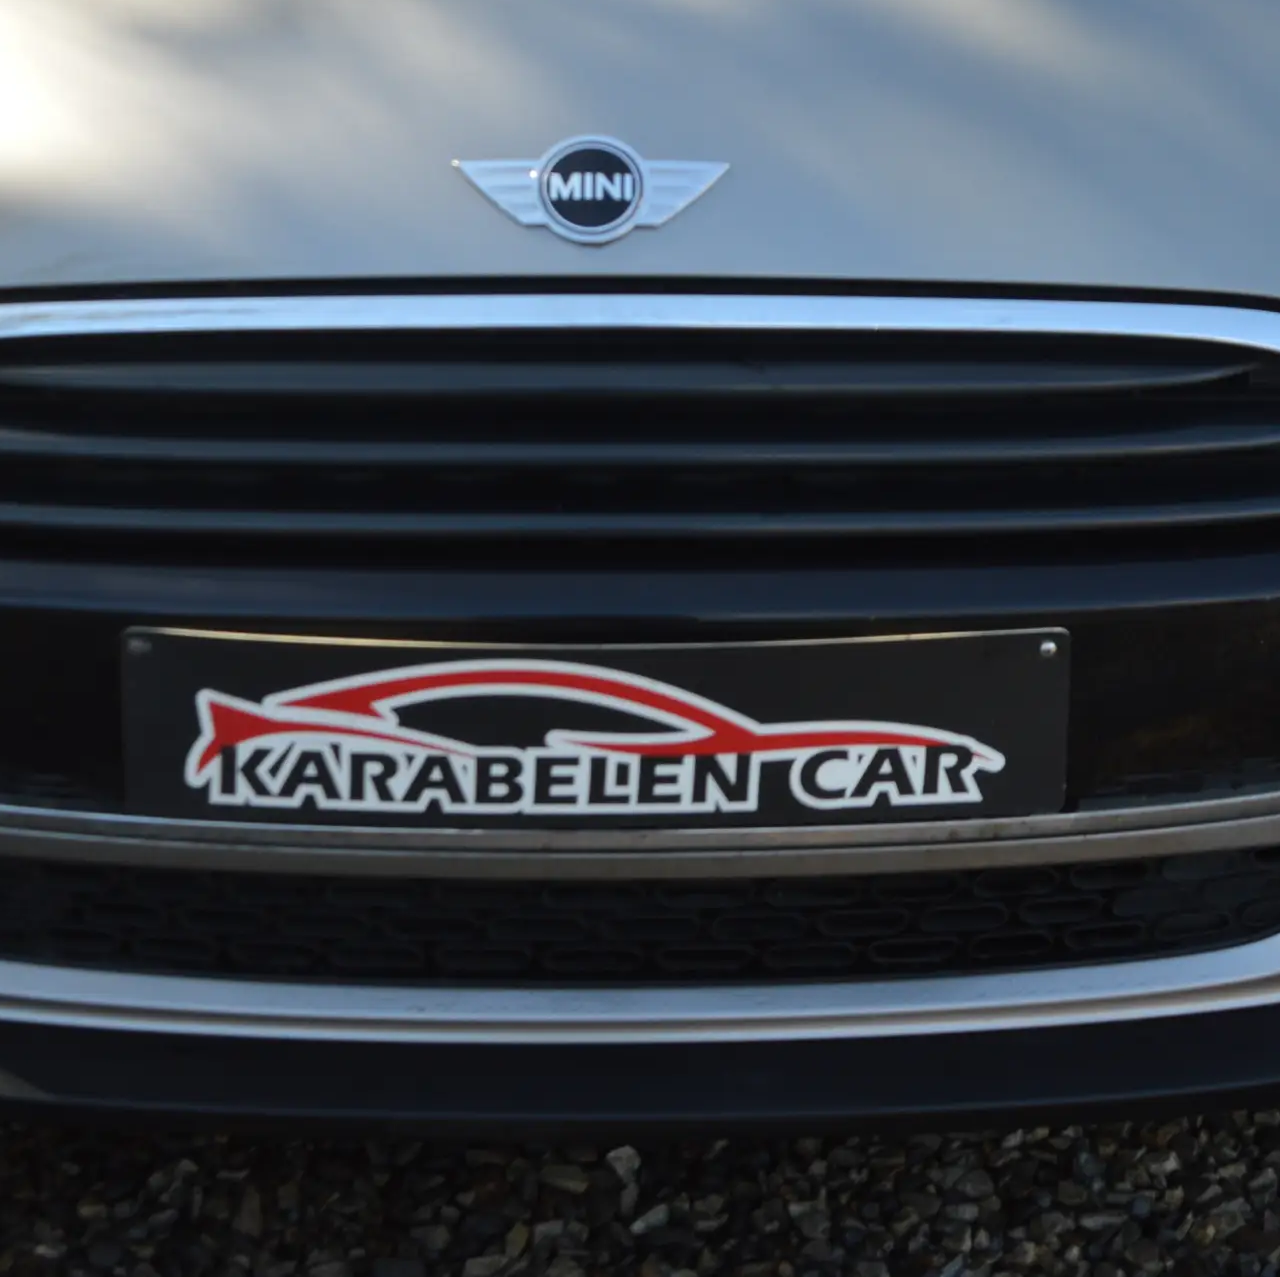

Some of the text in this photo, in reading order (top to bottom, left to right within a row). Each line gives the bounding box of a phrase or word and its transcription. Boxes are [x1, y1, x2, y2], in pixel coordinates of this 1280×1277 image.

[548, 171, 635, 201] MINI
[218, 744, 974, 806] KARABELEN CAR
